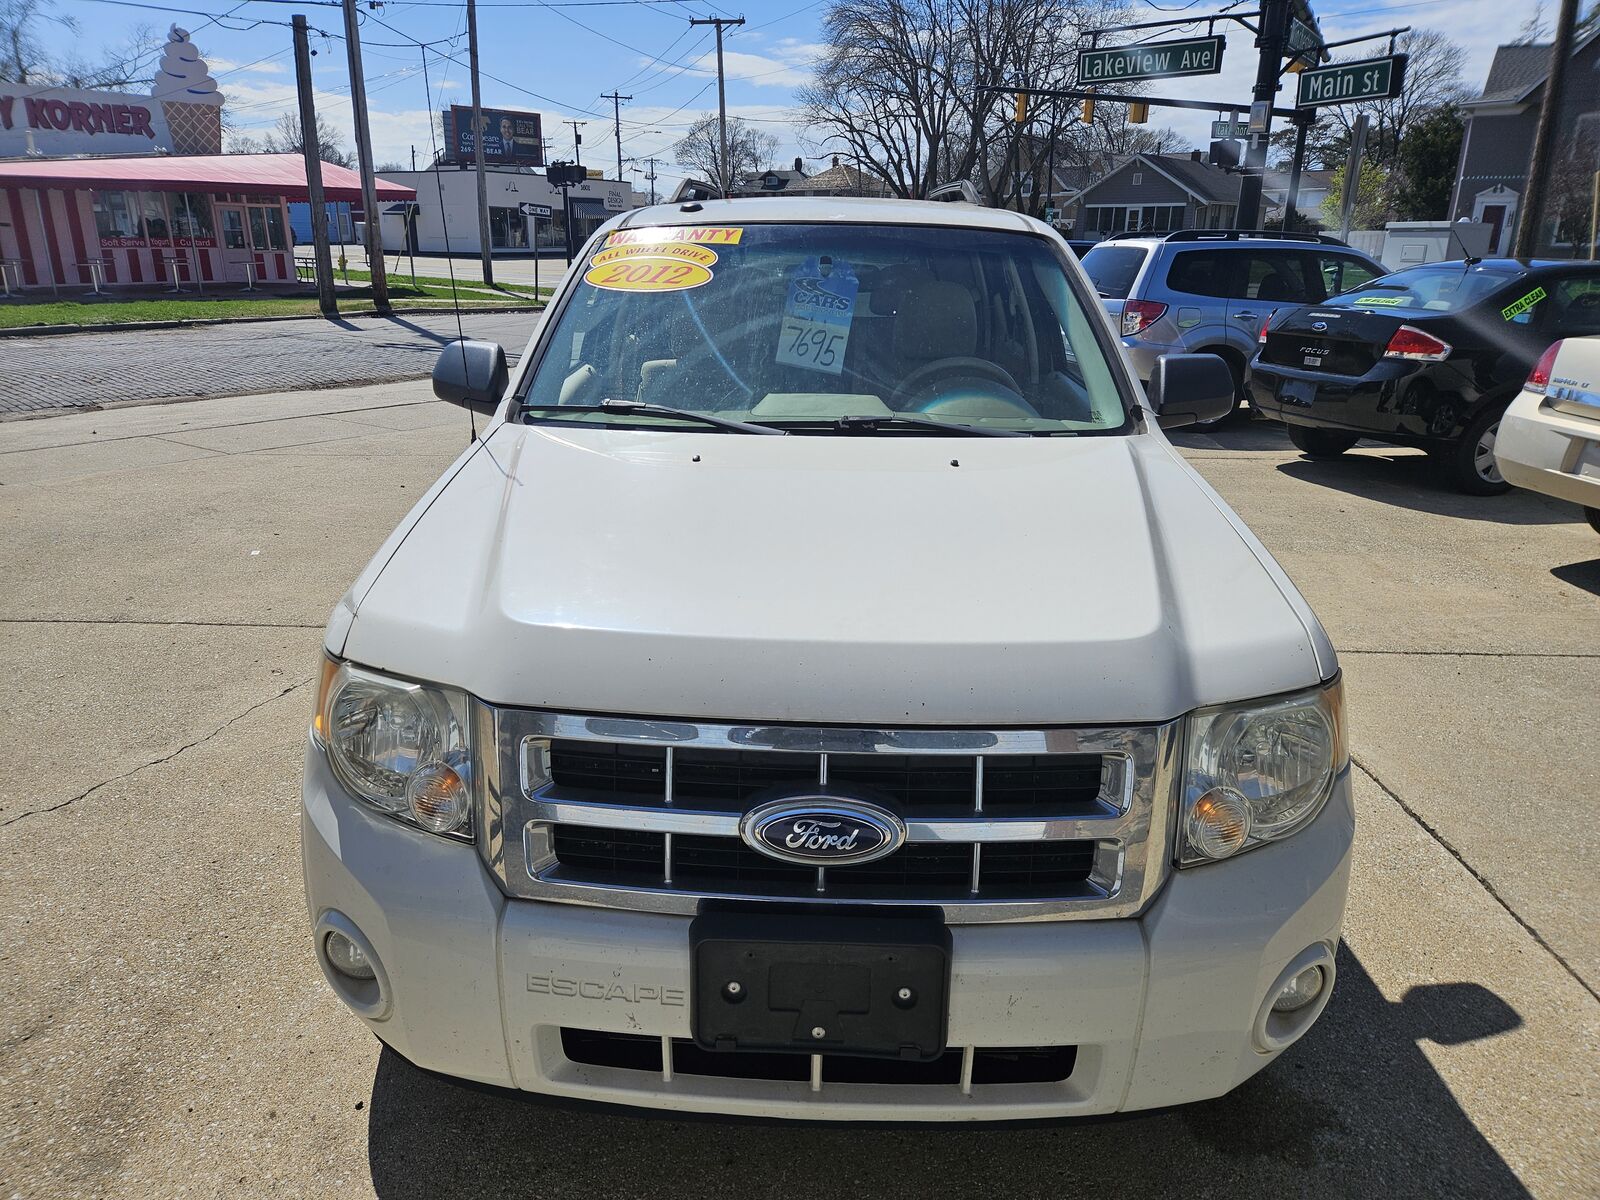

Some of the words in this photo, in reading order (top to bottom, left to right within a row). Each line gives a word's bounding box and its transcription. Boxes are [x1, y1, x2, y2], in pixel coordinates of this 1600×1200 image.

[1083, 50, 1170, 79] Lakeview
[1181, 47, 1211, 70] Ave
[1308, 71, 1355, 100] Main
[1362, 70, 1380, 93] St
[24, 98, 156, 139] KORNER
[461, 132, 500, 143] Coneare
[460, 146, 502, 155] 269--BEAR
[608, 190, 622, 198] FINAL
[101, 238, 119, 247] Soft
[121, 239, 145, 247] Serve
[179, 239, 211, 247] Cutard
[609, 227, 738, 245] WAANTY
[599, 251, 619, 263] ALL
[672, 247, 710, 262] DRIVE
[602, 264, 693, 284] 2012
[793, 291, 851, 311] CARS
[1504, 304, 1525, 318] EXTRA
[1524, 289, 1545, 304] CLEAN
[787, 325, 844, 366] 7695
[1299, 346, 1330, 355] FOCUS
[784, 819, 860, 851] Ford
[525, 971, 686, 1006] ESCAPE
